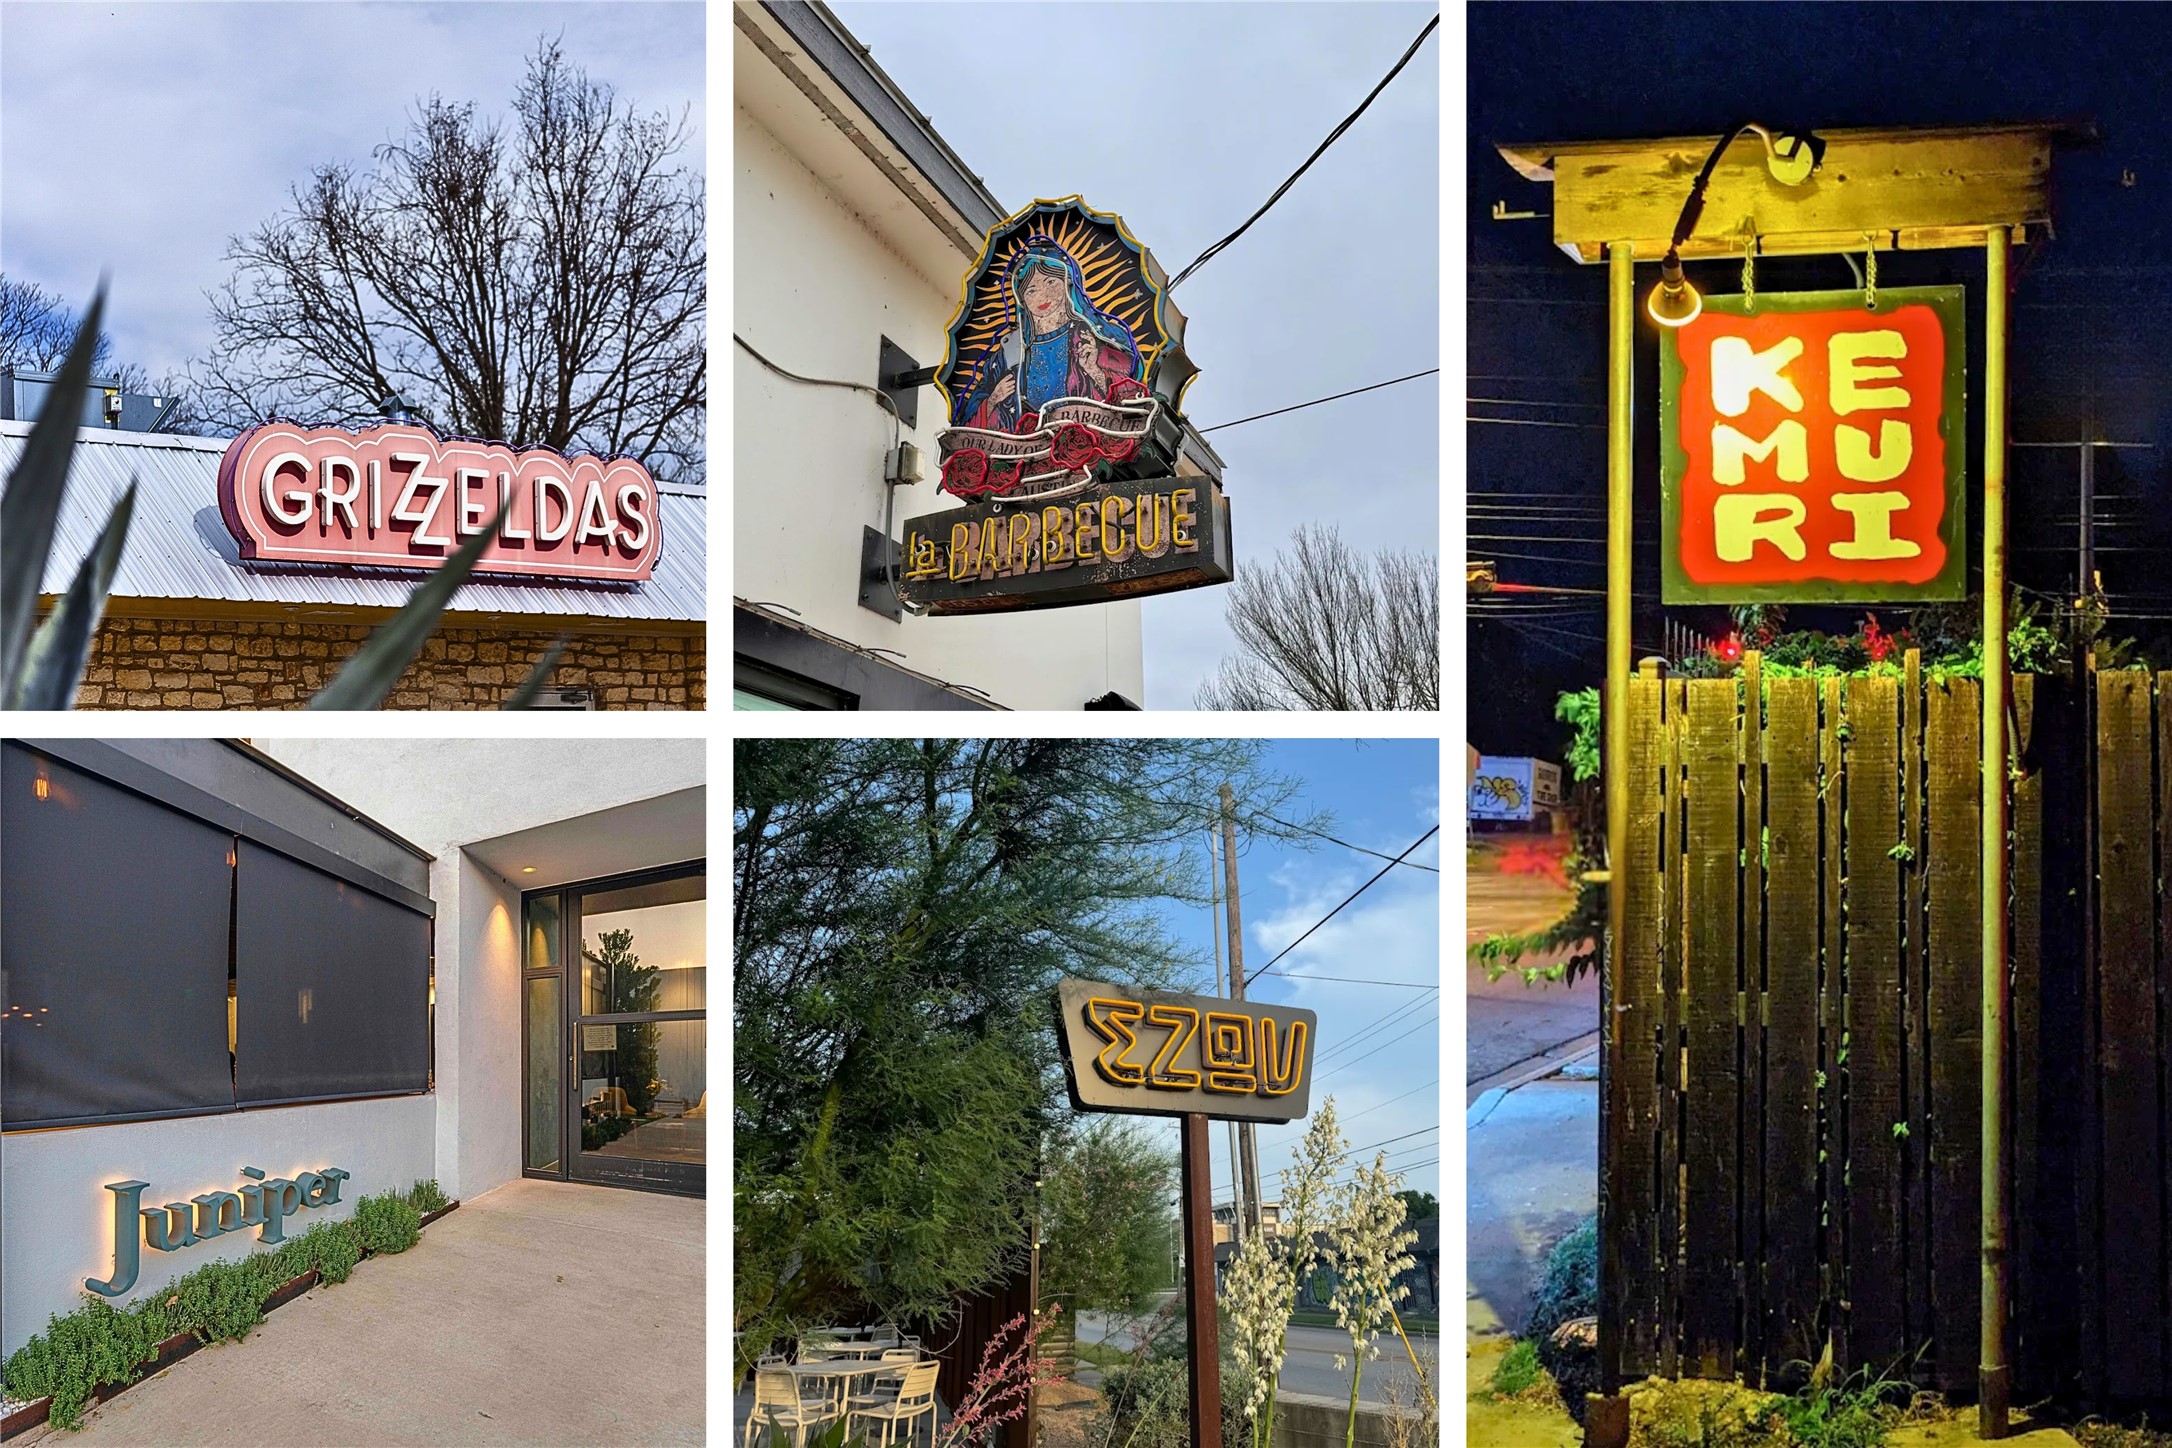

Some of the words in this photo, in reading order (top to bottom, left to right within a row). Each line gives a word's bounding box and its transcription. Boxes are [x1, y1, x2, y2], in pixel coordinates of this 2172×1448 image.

[961, 436, 987, 450] OUR
[987, 440, 1022, 455] LADY
[1060, 409, 1142, 432] BARBECUE
[261, 452, 649, 550] GRIZZELDAS
[949, 488, 1199, 584] BARBECUE
[82, 1166, 350, 1297] Juniper
